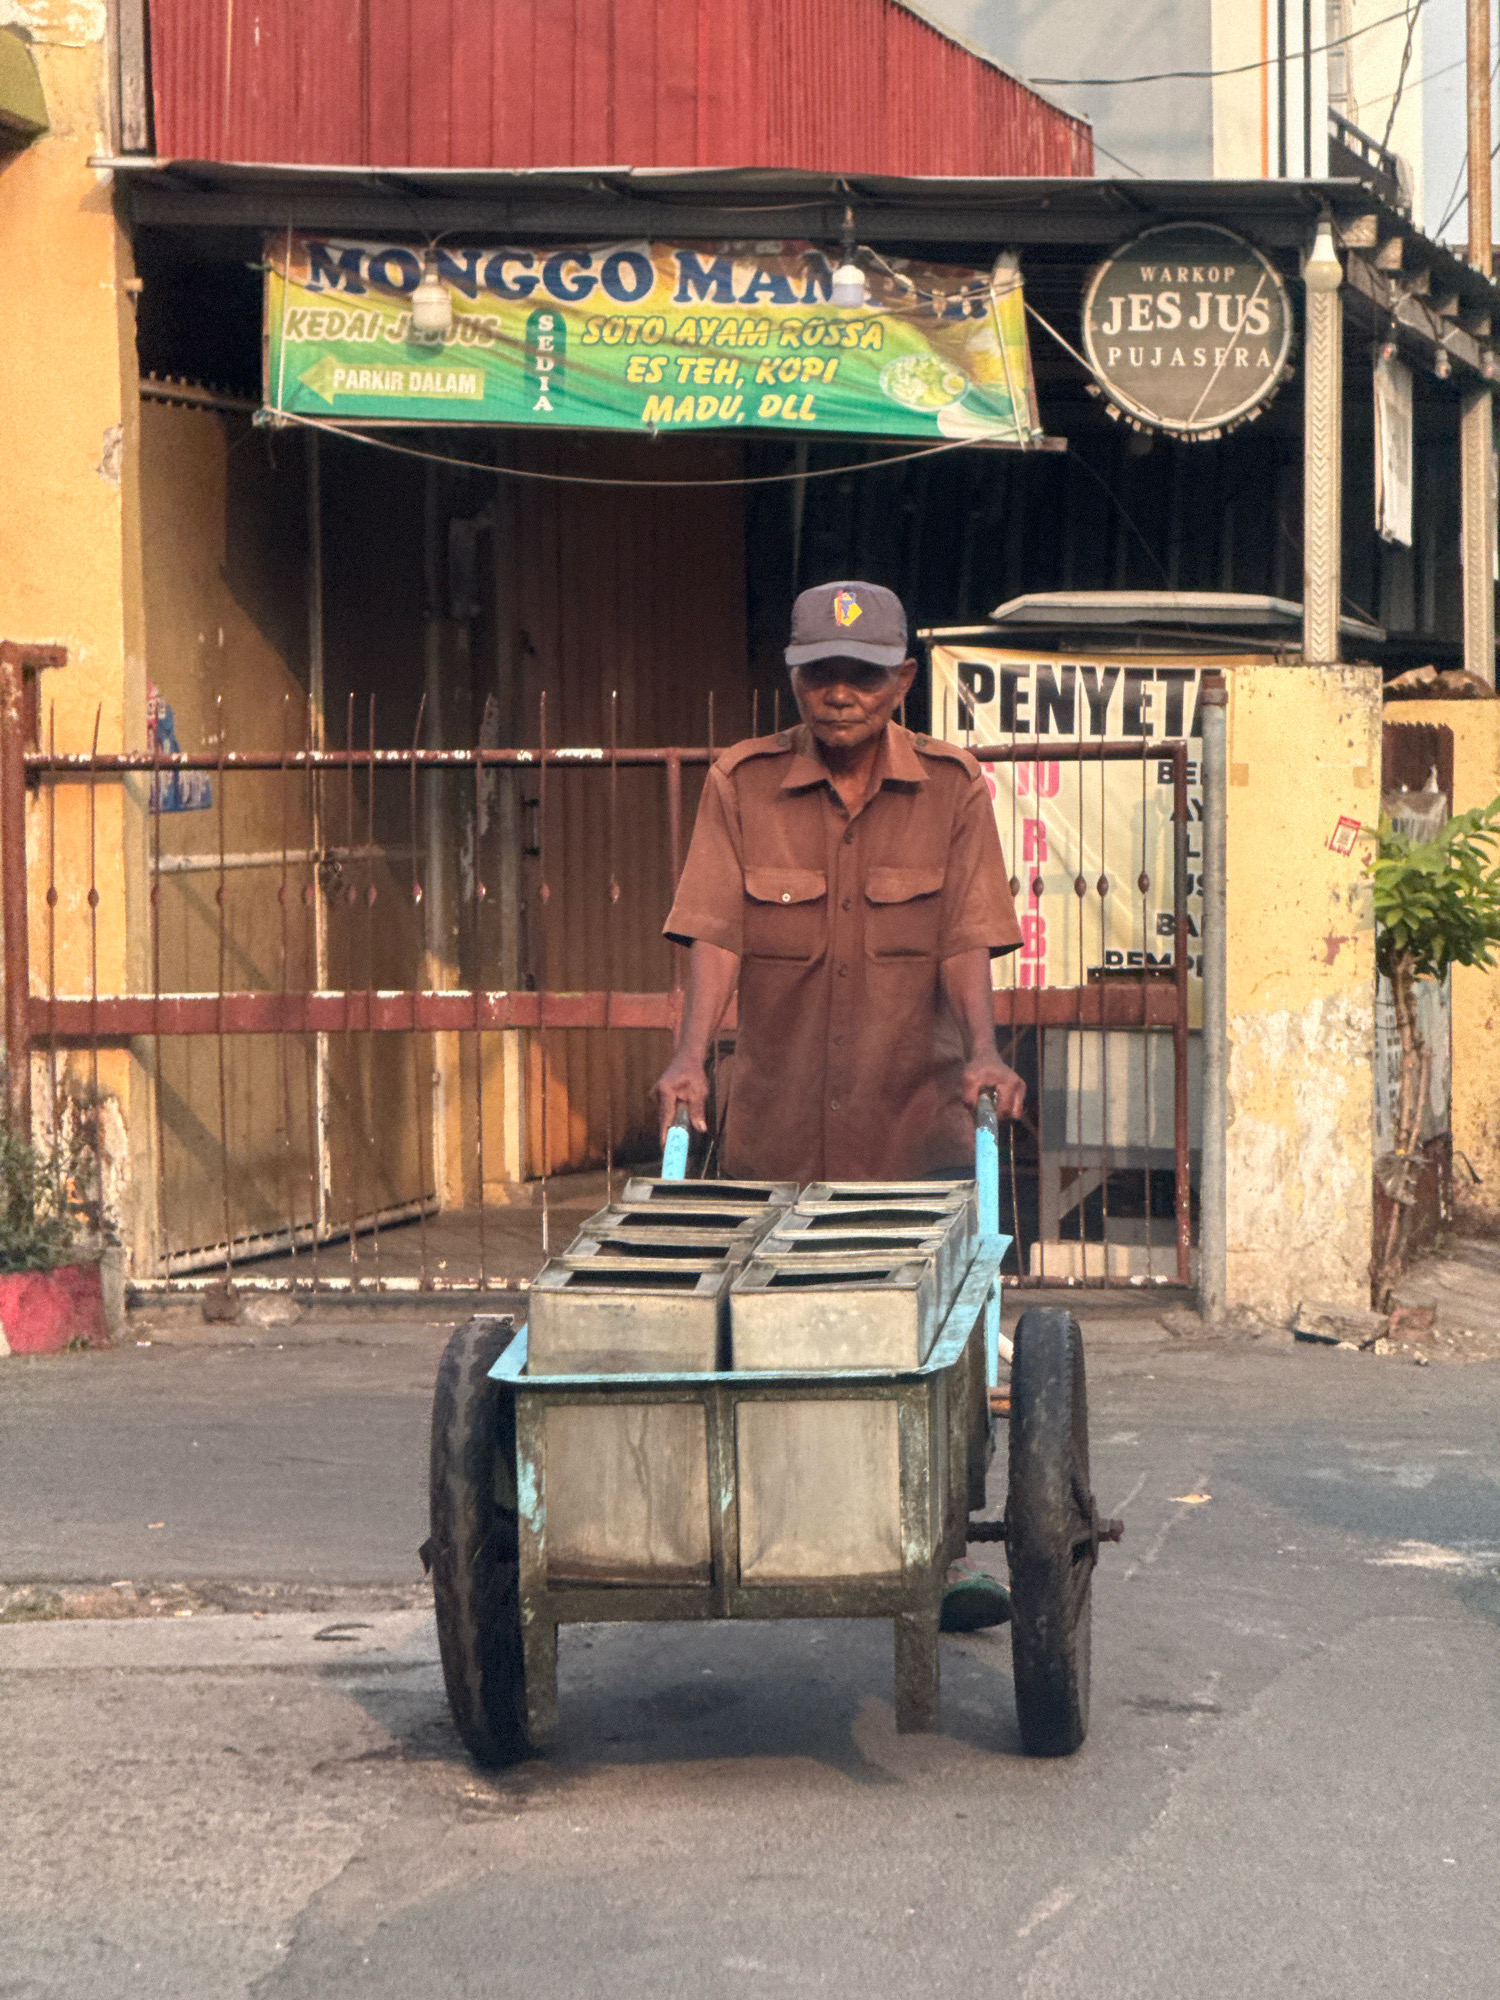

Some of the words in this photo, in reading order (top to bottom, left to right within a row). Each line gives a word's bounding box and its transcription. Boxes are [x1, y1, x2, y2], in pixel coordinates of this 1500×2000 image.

[307, 243, 653, 301] MONGGO
[1141, 266, 1235, 283] WARKOP
[284, 309, 380, 341] KEDAI
[581, 315, 667, 346] SOTO
[674, 317, 770, 348] AYAM
[779, 319, 884, 351] ROSSA
[532, 314, 553, 411] SEDIA
[627, 355, 669, 384] ES
[676, 356, 745, 390] TEH,
[755, 358, 839, 386] KOPI
[1108, 346, 1271, 367] PUJASERA
[333, 368, 404, 391] PARKIR
[409, 371, 476, 394] DALAM
[641, 394, 744, 424] MADU,
[757, 393, 817, 421] DLL
